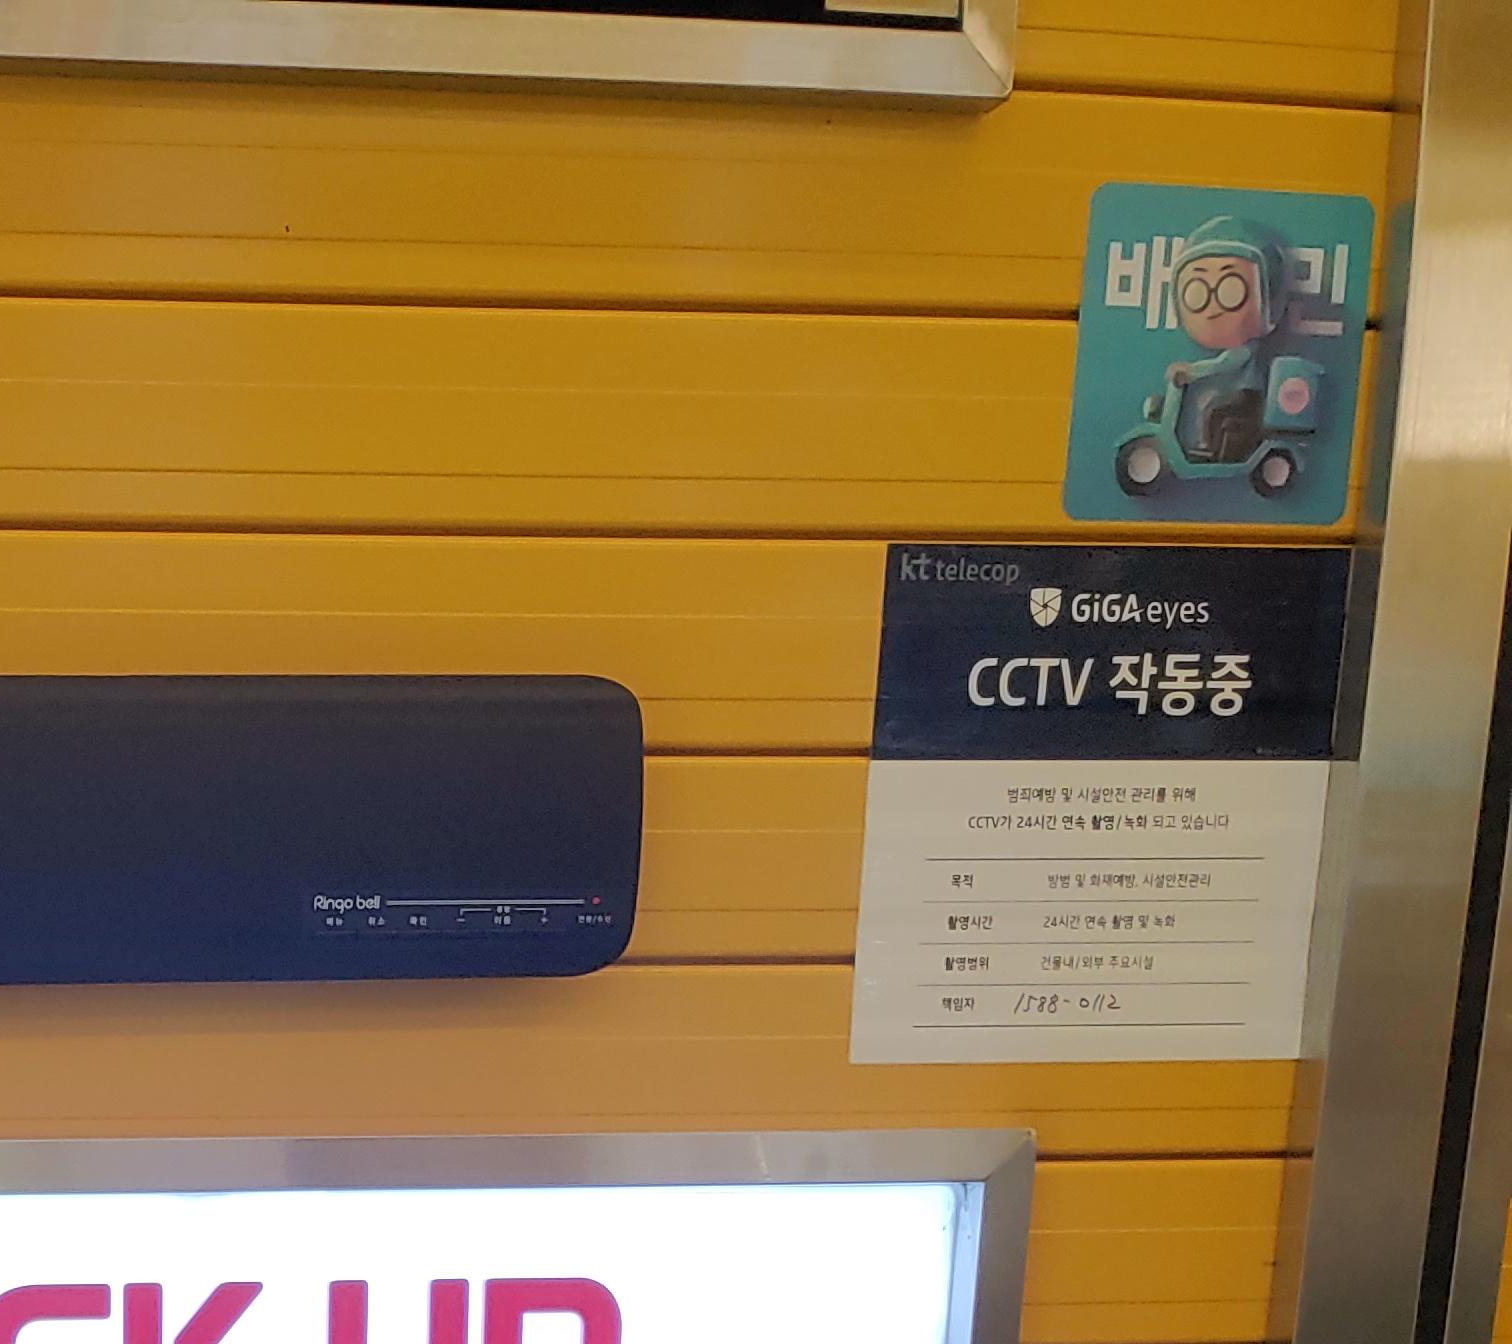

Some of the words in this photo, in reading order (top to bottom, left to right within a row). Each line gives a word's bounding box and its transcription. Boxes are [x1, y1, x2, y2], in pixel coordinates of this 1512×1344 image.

[899, 552, 931, 581] kt
[935, 556, 1020, 586] telecop
[967, 657, 1094, 707] CCTV
[1108, 652, 1253, 717] 작동중
[1006, 786, 1056, 803] 범죄예방
[1060, 786, 1074, 802] 및
[1076, 786, 1127, 803] 시설안전
[1130, 785, 1166, 803] 관리를
[1171, 785, 1197, 802] 위해
[967, 814, 1012, 831] CCTV가
[1016, 814, 1057, 831] 24시간
[1061, 814, 1086, 831] 연속
[1152, 814, 1177, 830] 되고
[1180, 814, 1230, 830] 있습니다
[951, 872, 975, 889] 목적
[1043, 914, 1081, 930] 24시간
[1084, 914, 1108, 930] 연속
[1108, 955, 1155, 972] 주요시설
[1013, 991, 1122, 1016] 1588-0112
